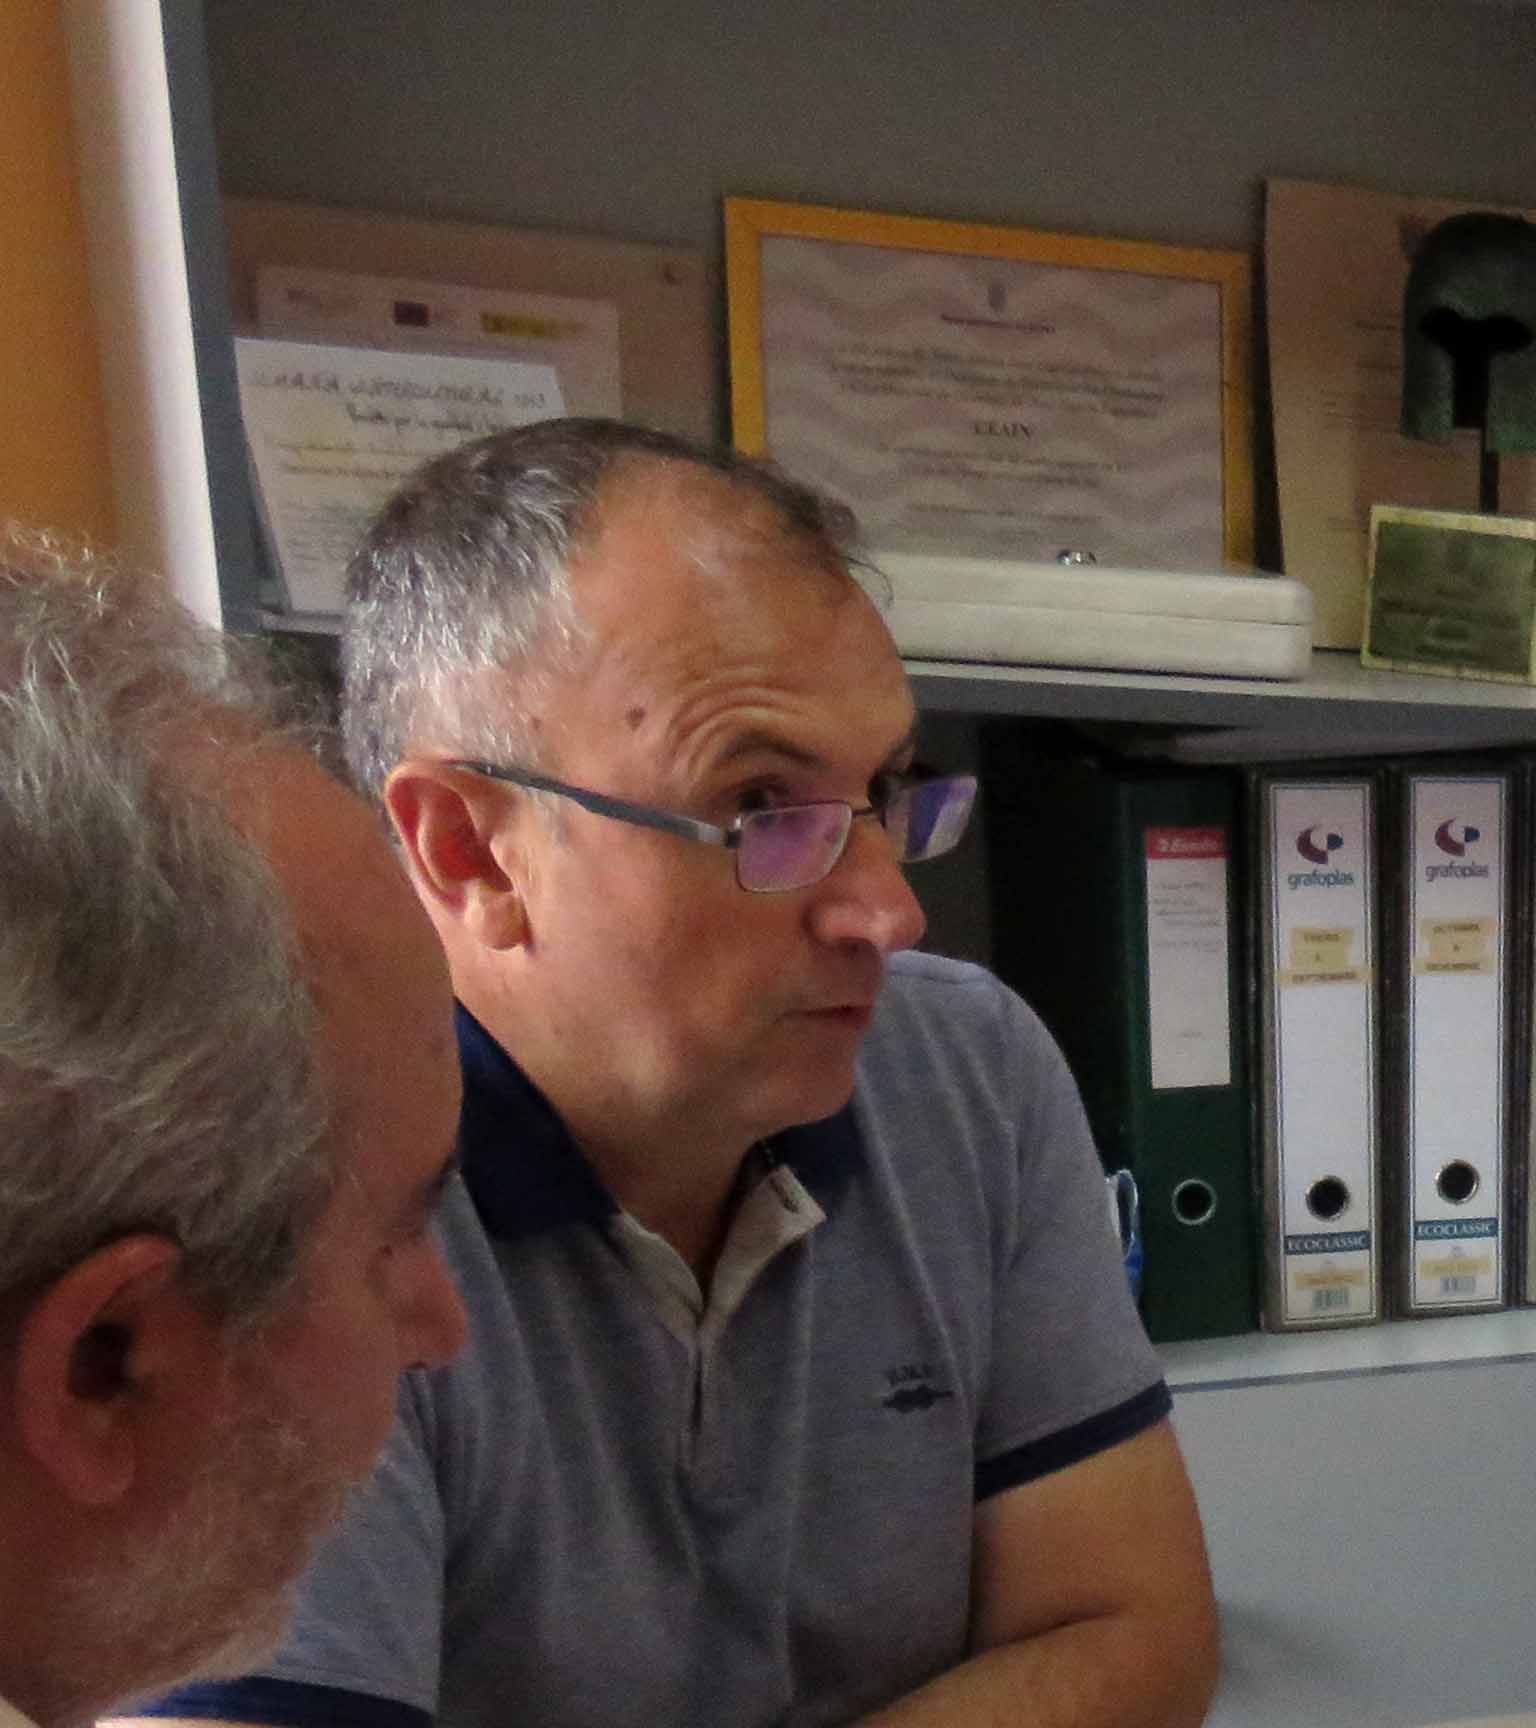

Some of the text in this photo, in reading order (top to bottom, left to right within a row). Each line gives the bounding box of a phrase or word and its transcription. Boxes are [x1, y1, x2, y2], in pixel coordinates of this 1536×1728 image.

[1287, 868, 1354, 890] grafoplas
[1424, 860, 1489, 882] grafoplas
[1417, 1220, 1493, 1236] ECOCLASSIC
[1287, 1233, 1367, 1251] ECOCLASSIC
